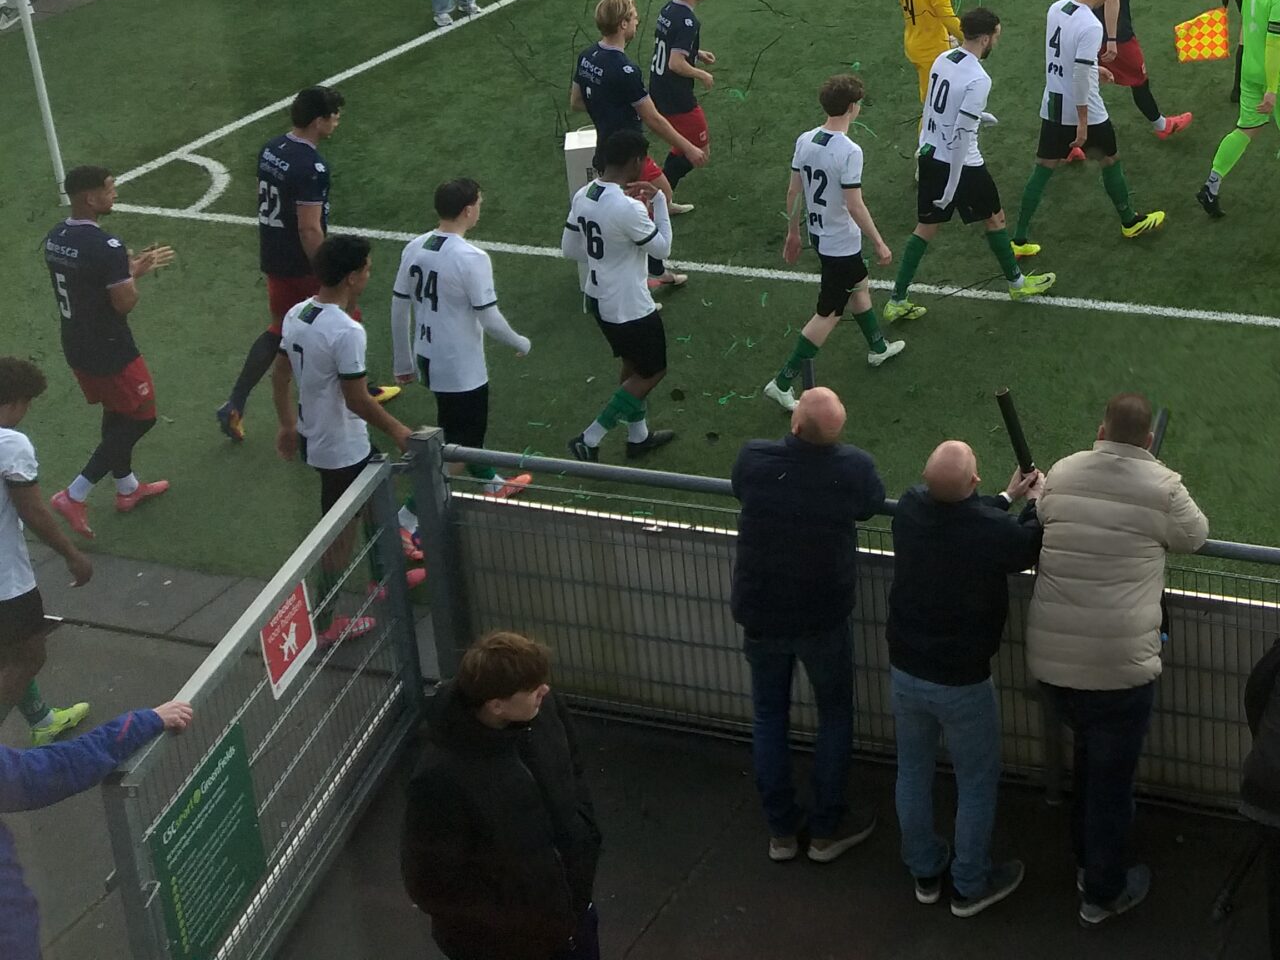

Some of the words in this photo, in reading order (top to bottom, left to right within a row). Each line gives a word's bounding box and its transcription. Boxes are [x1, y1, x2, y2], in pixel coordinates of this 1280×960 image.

[1049, 25, 1062, 58] 4
[930, 72, 950, 115] 10
[259, 180, 285, 228] 22
[803, 165, 828, 207] 12
[55, 272, 72, 319] 5
[410, 265, 439, 313] 24
